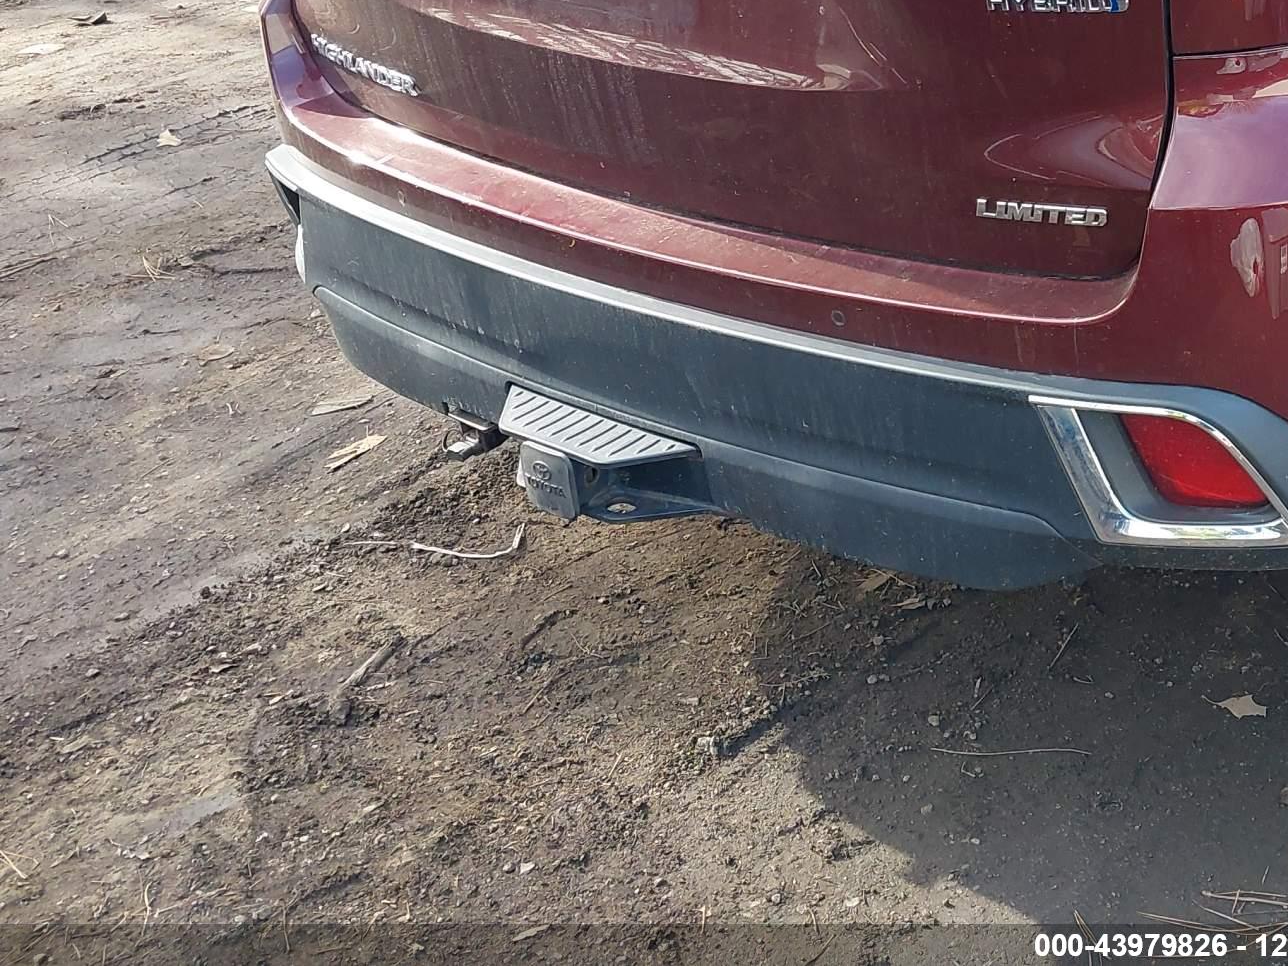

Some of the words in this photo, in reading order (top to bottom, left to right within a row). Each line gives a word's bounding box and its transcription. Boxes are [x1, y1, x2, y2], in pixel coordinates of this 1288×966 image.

[310, 33, 418, 97] HIGHLANDER
[976, 198, 1107, 227] LIMITED
[525, 472, 567, 499] TOYOTA
